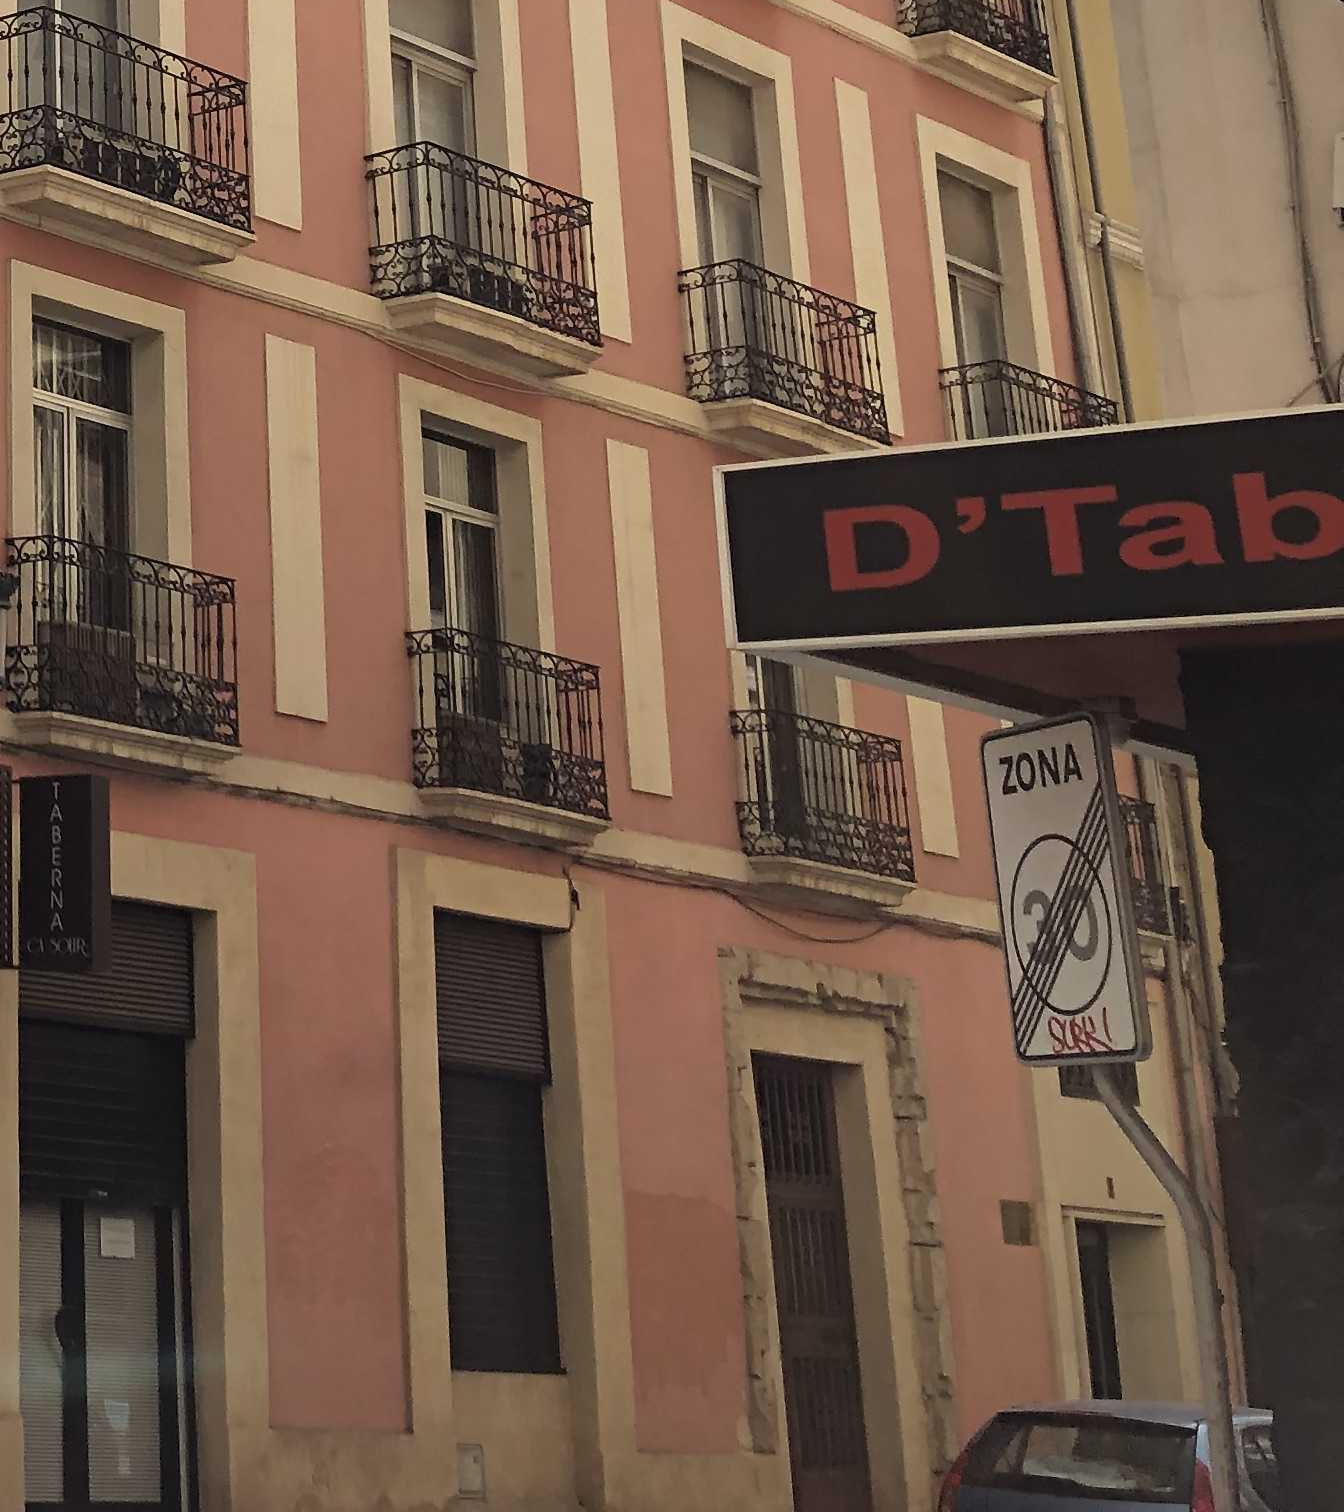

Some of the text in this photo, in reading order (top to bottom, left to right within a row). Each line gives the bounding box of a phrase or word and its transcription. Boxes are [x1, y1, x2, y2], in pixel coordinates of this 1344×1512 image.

[999, 743, 1083, 795] ZONA
[50, 781, 63, 932] TABERNA
[1022, 885, 1099, 963] 30
